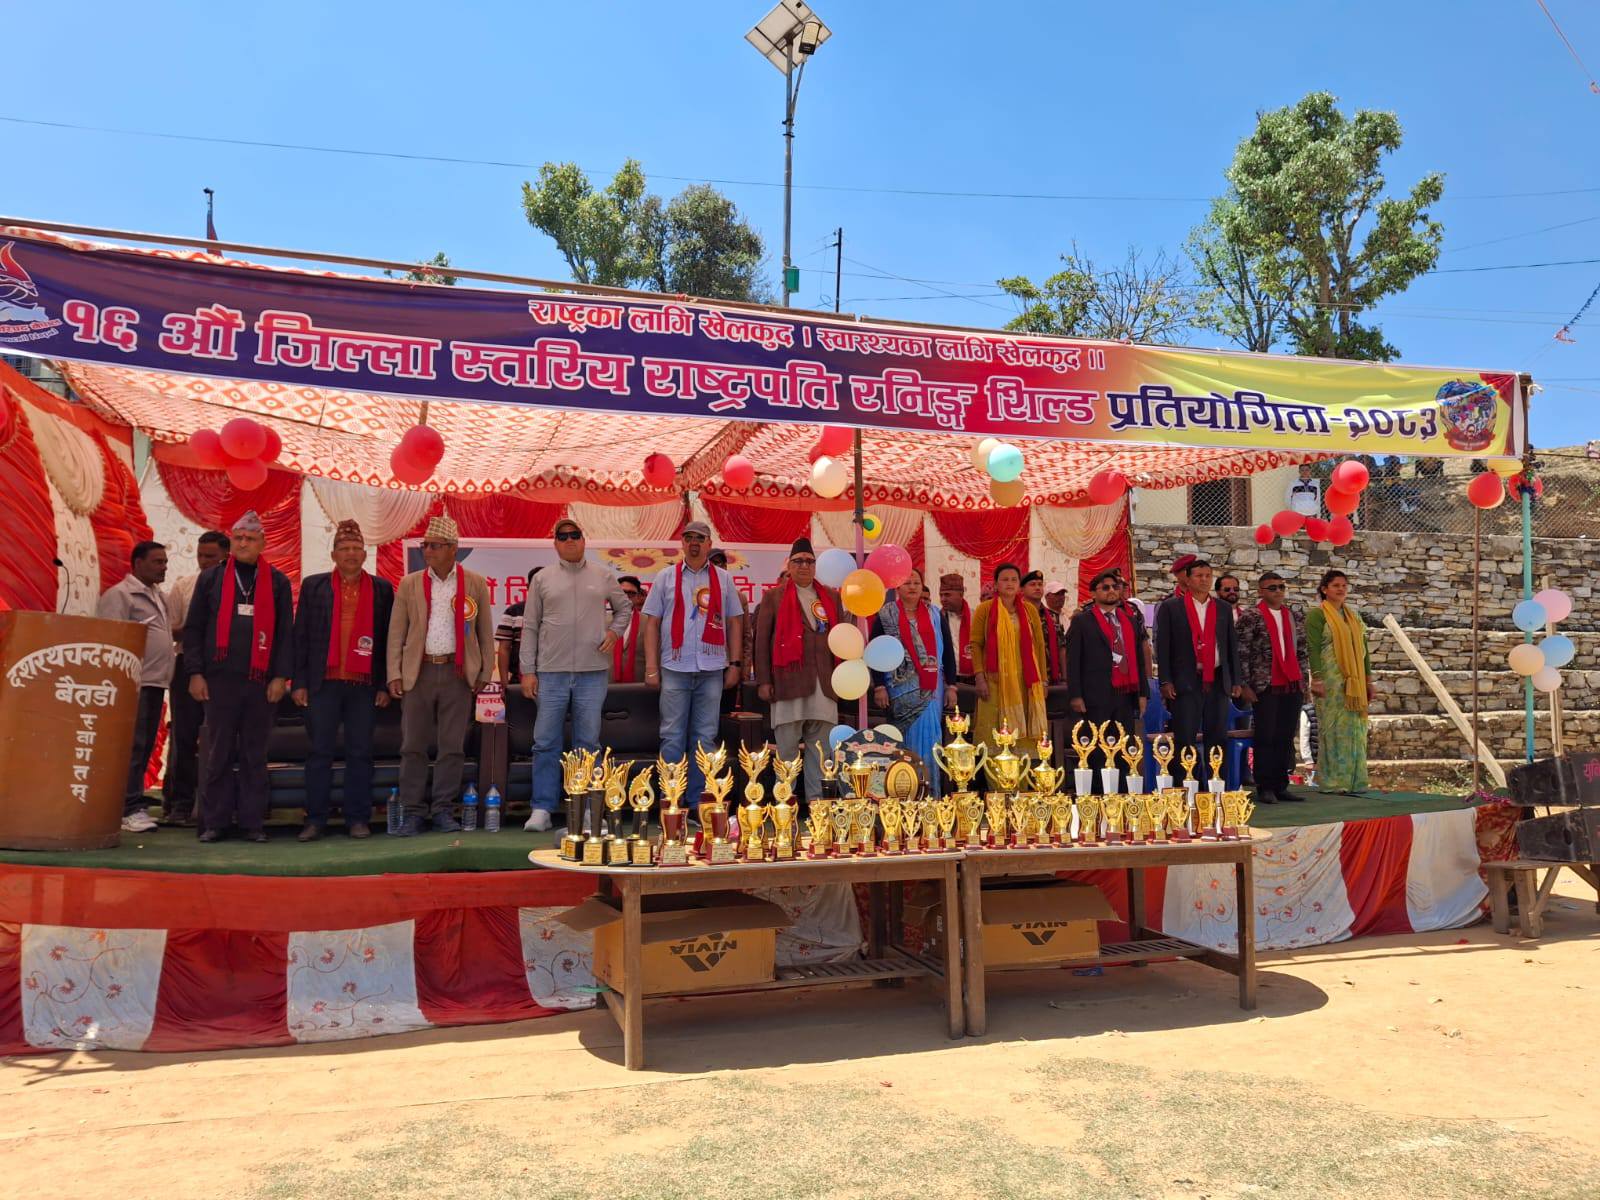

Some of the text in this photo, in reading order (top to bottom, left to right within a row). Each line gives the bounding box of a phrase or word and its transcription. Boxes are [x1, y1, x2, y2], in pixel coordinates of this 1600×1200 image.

[62, 299, 140, 352] १६
[253, 310, 442, 380] जिल्ला
[642, 359, 842, 412] राष्ट्रपति
[985, 375, 1099, 424] शिल्ड
[528, 300, 622, 332] राष्ट्रका
[628, 305, 693, 335] लागि
[699, 310, 794, 351] खेलकुद
[937, 336, 993, 362] लागि
[996, 342, 1081, 374] खेलकुद
[54, 675, 118, 708] बैतडी
[669, 939, 738, 956] NIVIA
